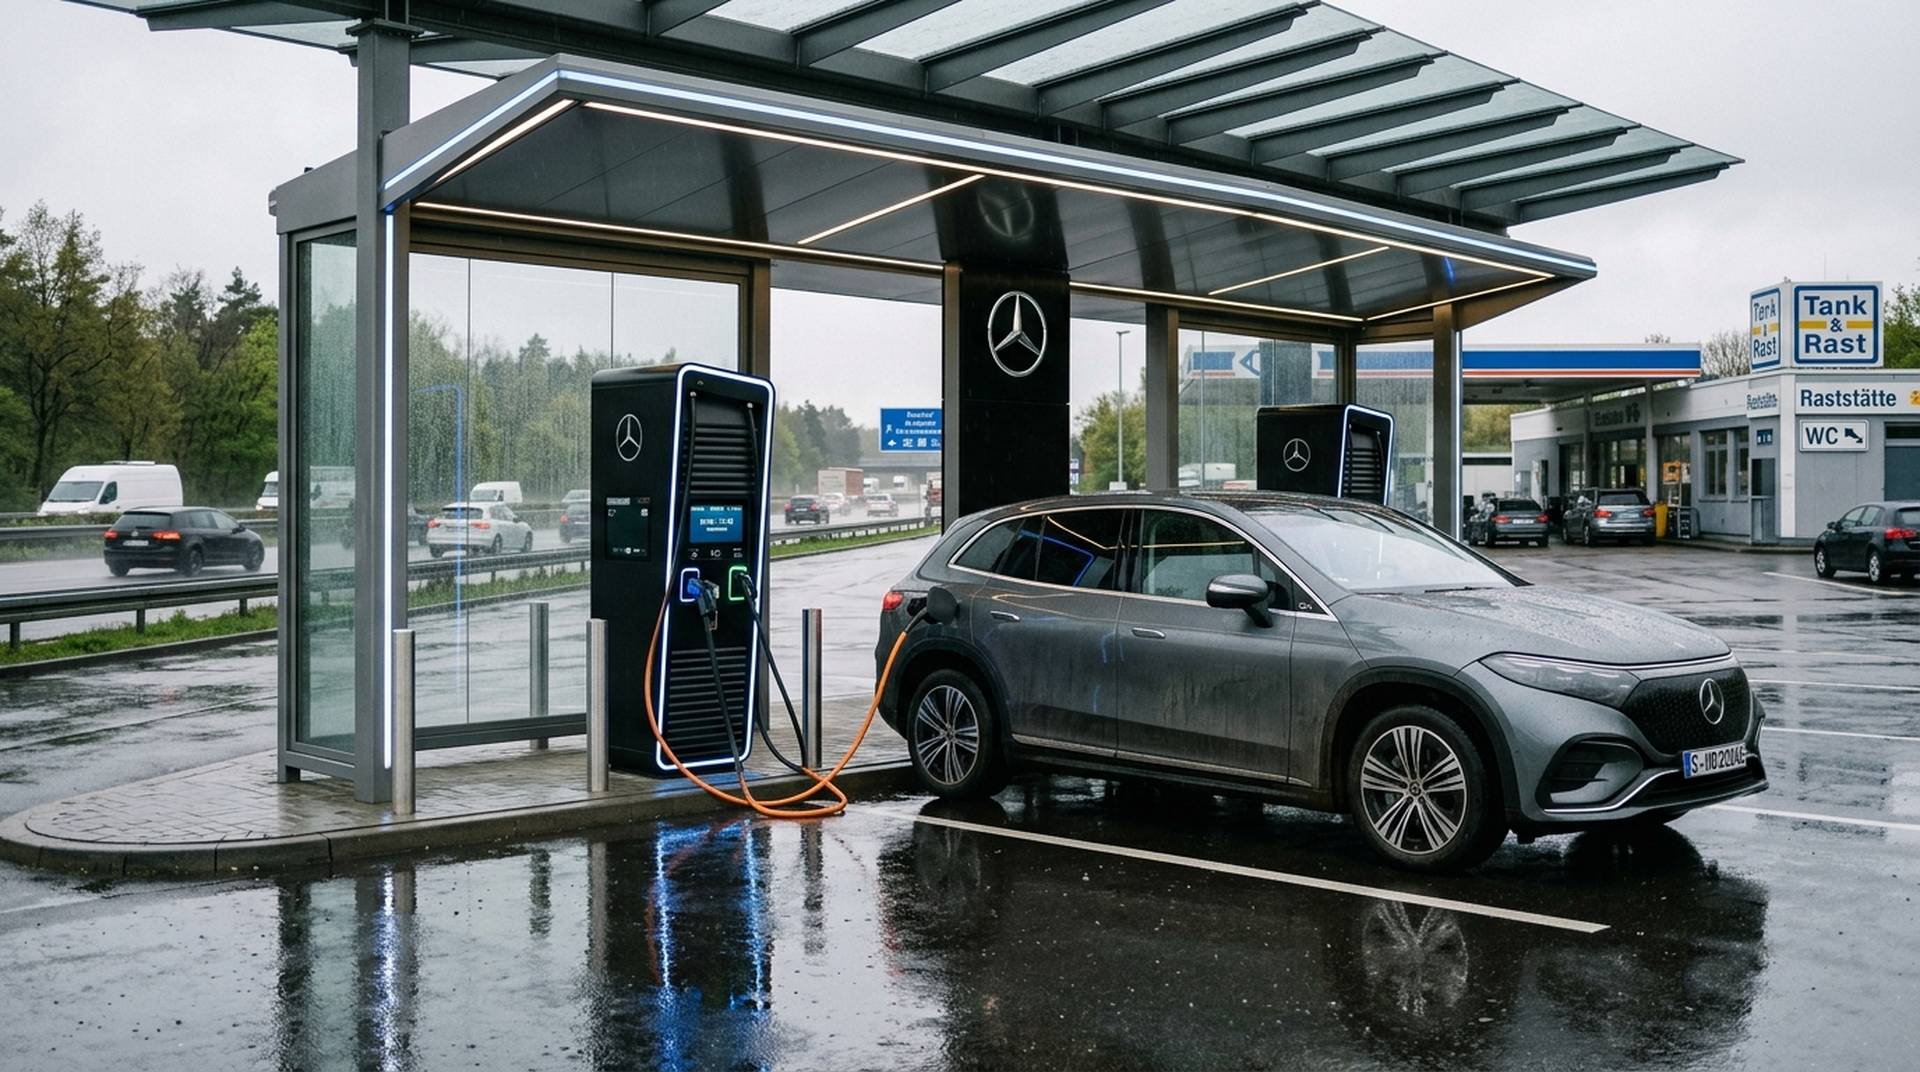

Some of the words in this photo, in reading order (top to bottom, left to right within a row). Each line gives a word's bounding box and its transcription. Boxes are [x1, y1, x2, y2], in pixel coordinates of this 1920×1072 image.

[1804, 295, 1867, 315] Tank
[1830, 318, 1842, 332] &
[1754, 337, 1776, 358] Rast
[1805, 334, 1866, 353] Rast
[1801, 388, 1896, 407] Raststätte
[1805, 427, 1838, 444] WC
